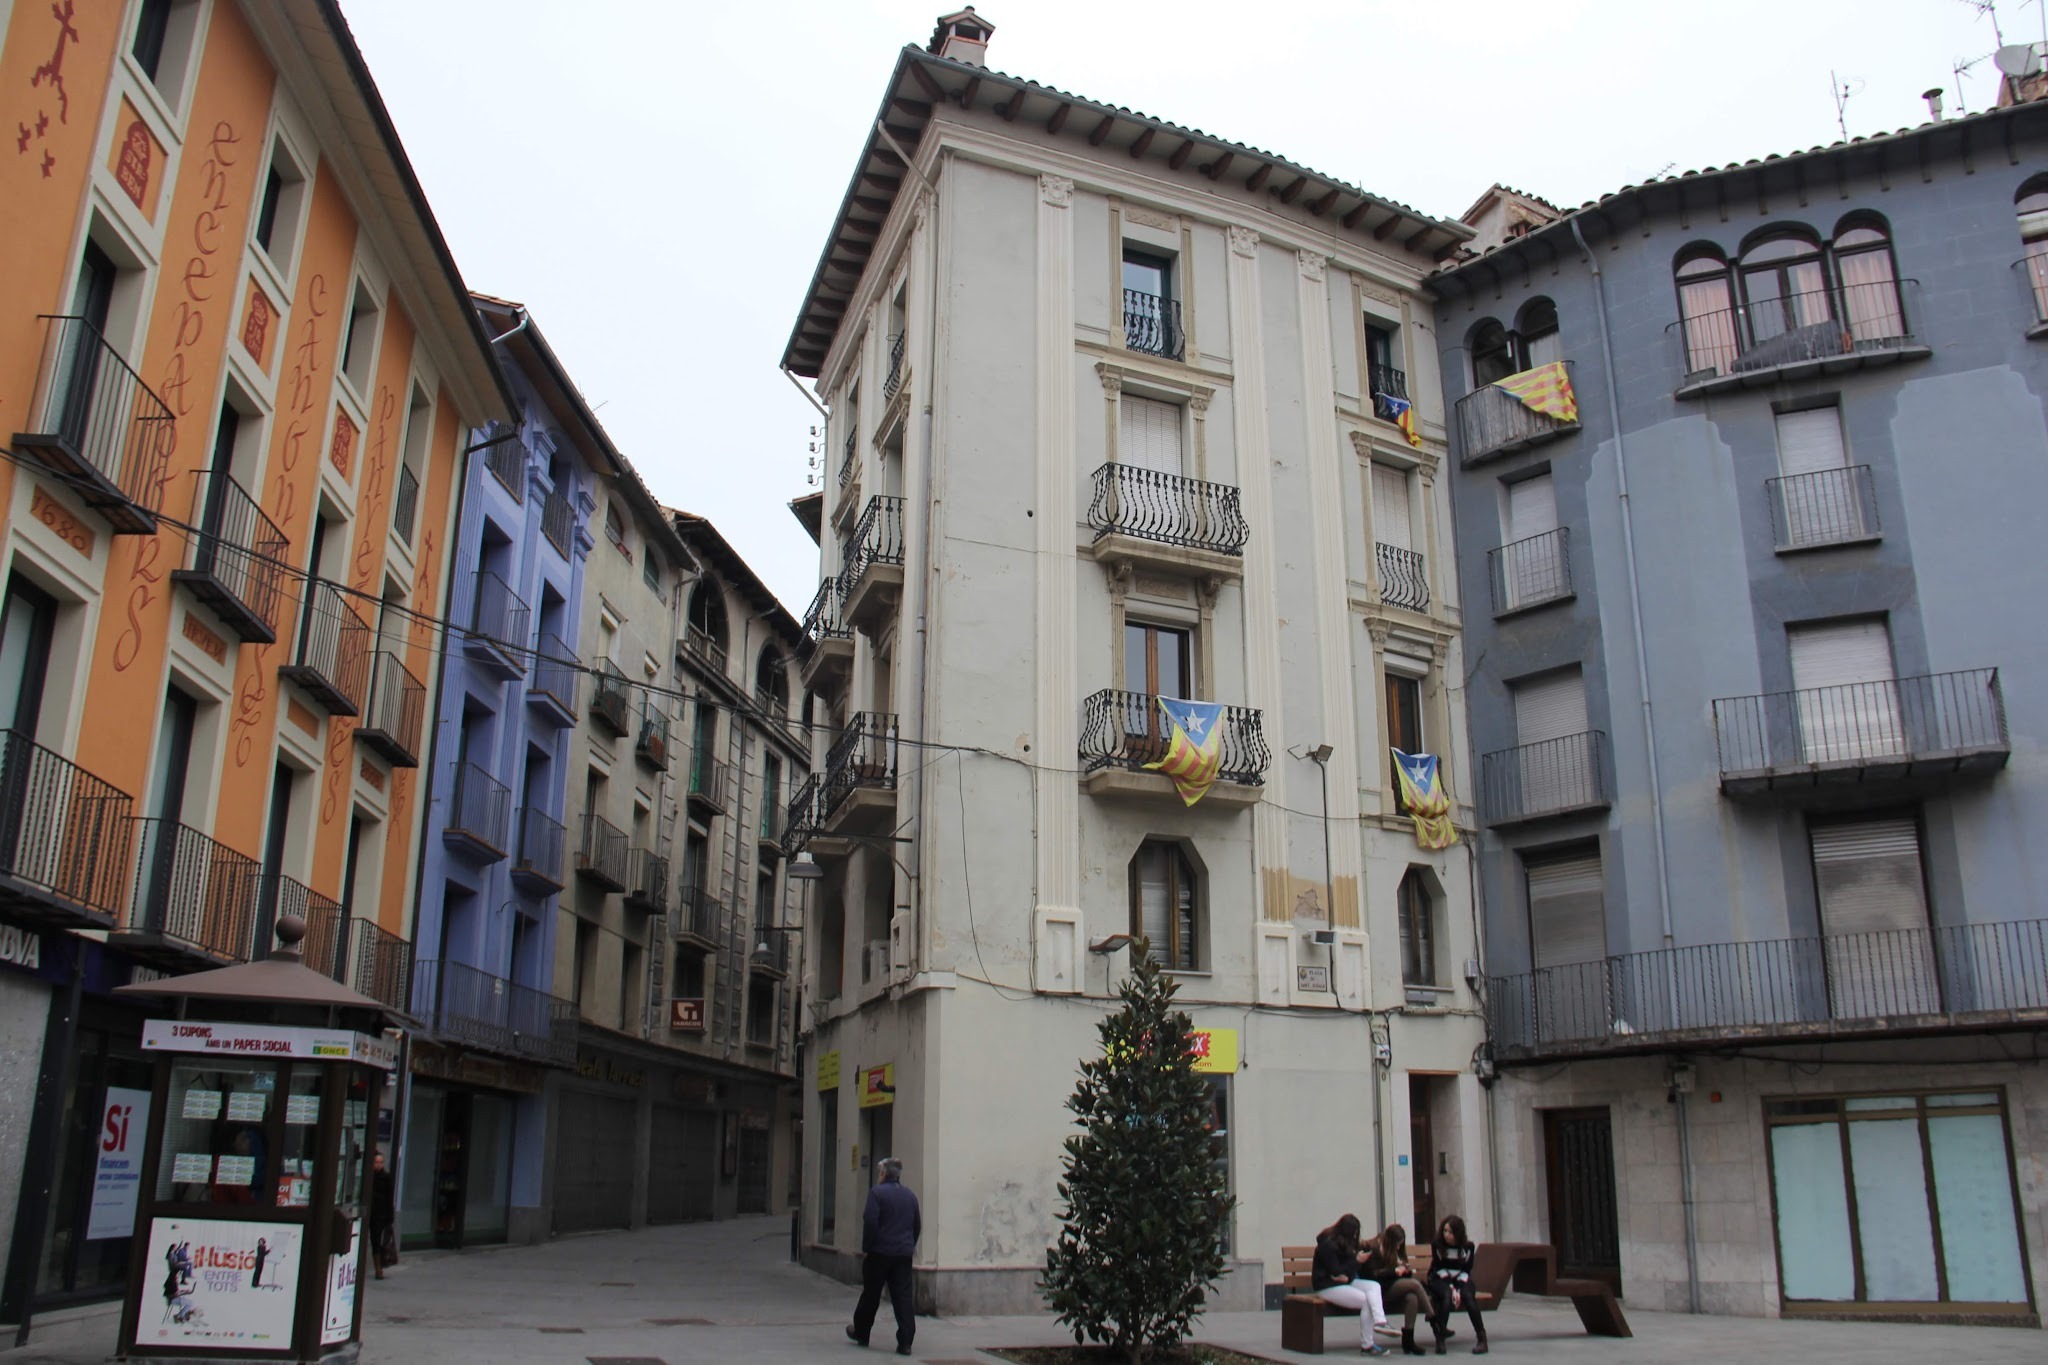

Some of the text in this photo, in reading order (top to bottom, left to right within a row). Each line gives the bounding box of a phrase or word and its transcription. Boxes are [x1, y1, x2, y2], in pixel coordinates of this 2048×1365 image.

[0, 922, 41, 969] BVA
[172, 1025, 213, 1039] 3 CUPONS
[233, 1038, 262, 1052] PAPER
[262, 1039, 292, 1053] SOCIAL
[102, 1103, 132, 1152] Sí
[204, 1269, 242, 1282] ENTRE
[207, 1281, 238, 1293] TOTS
